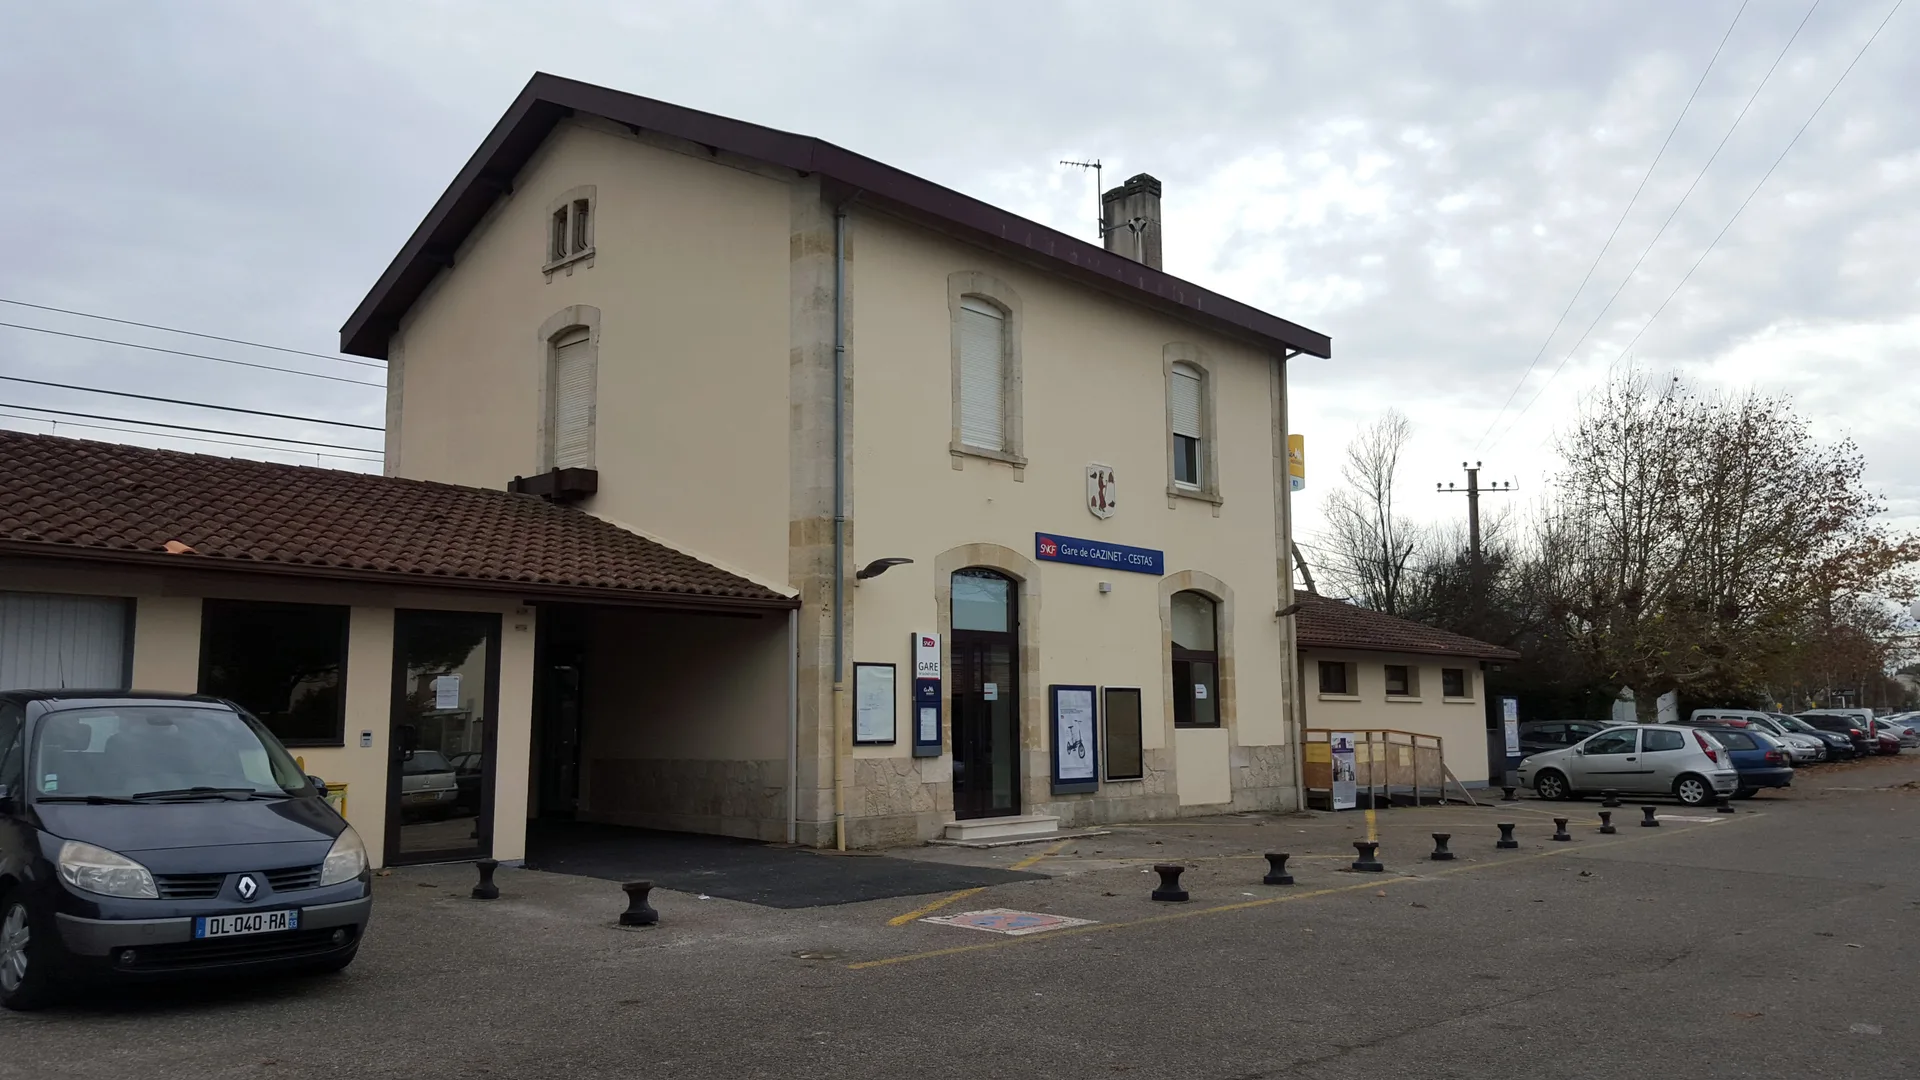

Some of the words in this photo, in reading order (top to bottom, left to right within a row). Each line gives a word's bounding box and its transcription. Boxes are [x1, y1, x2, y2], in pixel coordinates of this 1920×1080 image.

[1040, 543, 1057, 554] SNCF
[1061, 544, 1078, 556] Gare
[1080, 547, 1088, 558] de
[1090, 548, 1122, 562] GAZINET
[1128, 553, 1153, 566] CESTAS
[918, 661, 939, 672] GARE
[210, 913, 286, 935] DL-040-RA
